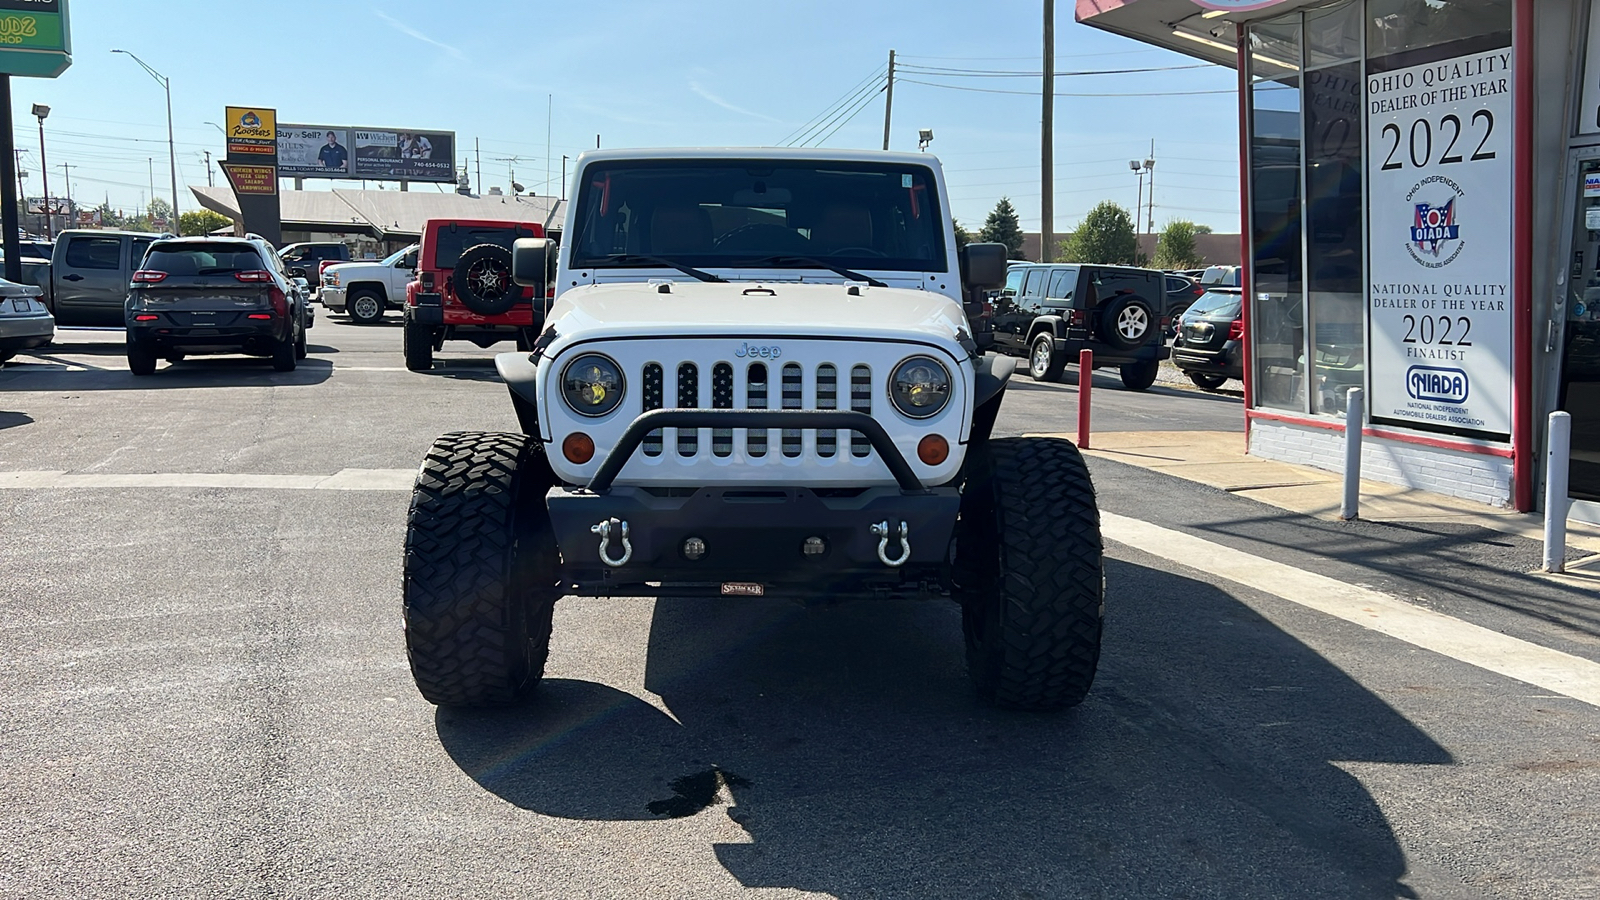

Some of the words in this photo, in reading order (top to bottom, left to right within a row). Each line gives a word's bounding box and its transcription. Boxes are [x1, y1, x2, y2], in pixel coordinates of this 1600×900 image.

[1370, 73, 1414, 94] OHIO
[1422, 53, 1510, 86] QUALITY
[1371, 94, 1418, 114] DEALER
[1420, 91, 1437, 106] OF
[1440, 86, 1467, 103] THE
[1471, 79, 1508, 98] YEAR
[232, 125, 270, 136] Roosters
[277, 131, 292, 139] Buy
[1381, 109, 1496, 170] 2022
[1406, 183, 1420, 202] OHIO
[1420, 176, 1464, 198] INDEPENDENT
[1416, 226, 1450, 240] OIADA
[1405, 243, 1425, 266] AUTOMOBILE
[1443, 240, 1465, 266] ASSOCIATION
[1372, 284, 1438, 294] NATIONAL
[1444, 284, 1507, 296] QUALITY
[1374, 299, 1416, 308] DEALER
[1422, 300, 1436, 309] OF
[1442, 300, 1465, 310] THE
[1471, 301, 1504, 311] YEAR
[1402, 314, 1472, 346] 2022
[735, 342, 782, 360] Jeep
[1407, 348, 1466, 361] FINALIST
[1411, 373, 1462, 396] NIADA
[1407, 402, 1432, 411] NATIONAL
[1433, 405, 1469, 415] INDEPENDENT
[1393, 409, 1424, 418] AUTOMOBILE
[1426, 412, 1447, 422] DEALERS
[1448, 416, 1485, 426] ASSOCIATION
